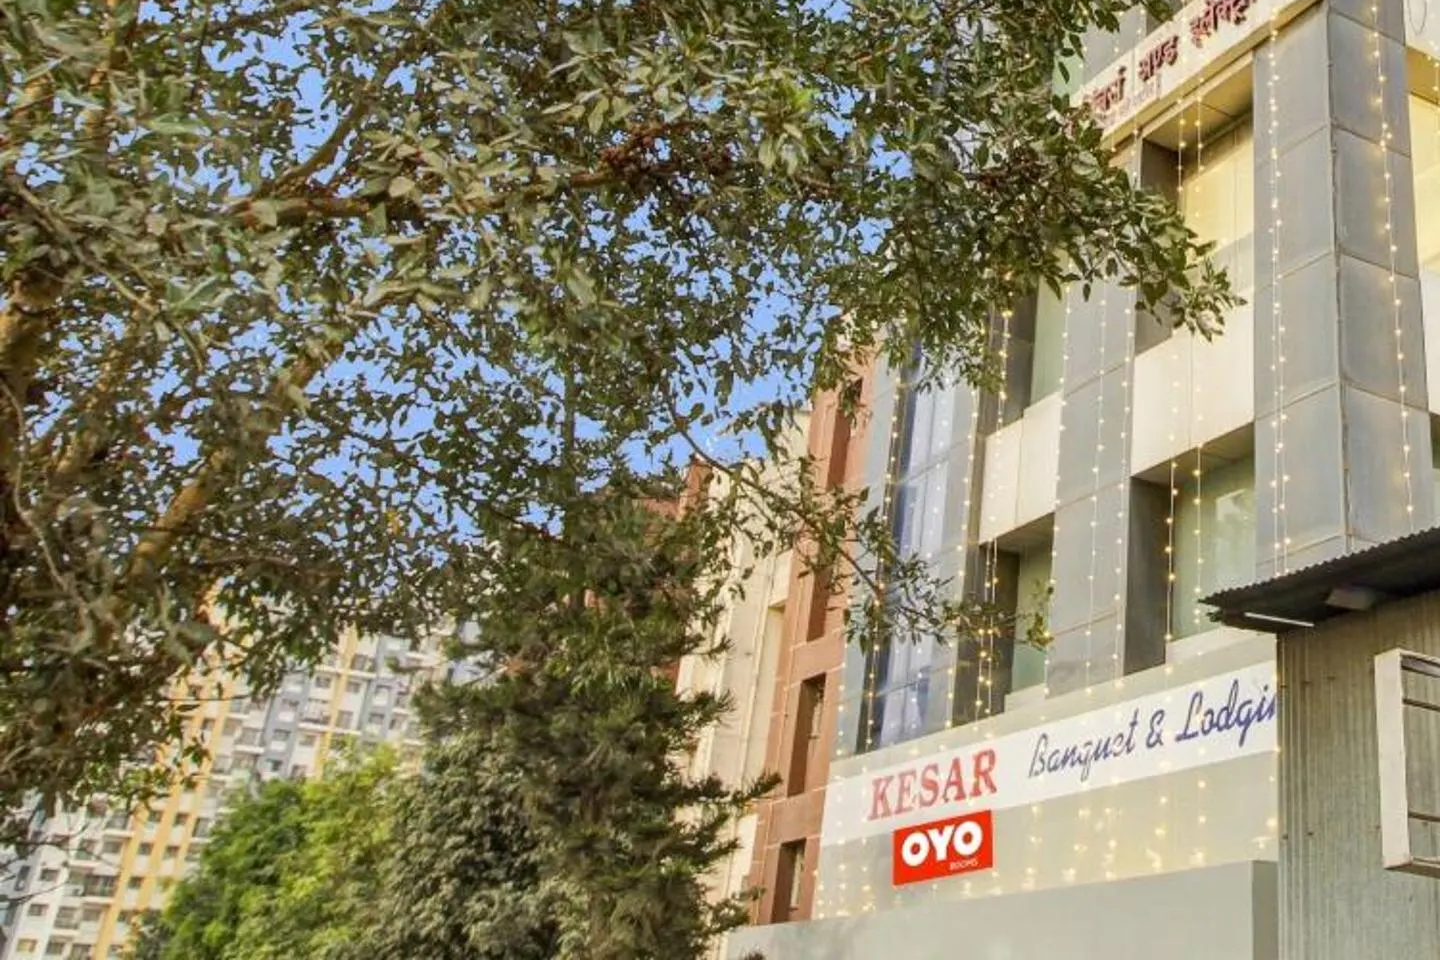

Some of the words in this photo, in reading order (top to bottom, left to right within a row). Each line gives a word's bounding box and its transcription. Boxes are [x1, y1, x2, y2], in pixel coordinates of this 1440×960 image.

[867, 748, 998, 822] KESAR
[1028, 711, 1138, 781] Banquet
[1146, 709, 1165, 748] &
[901, 820, 983, 867] OYO
